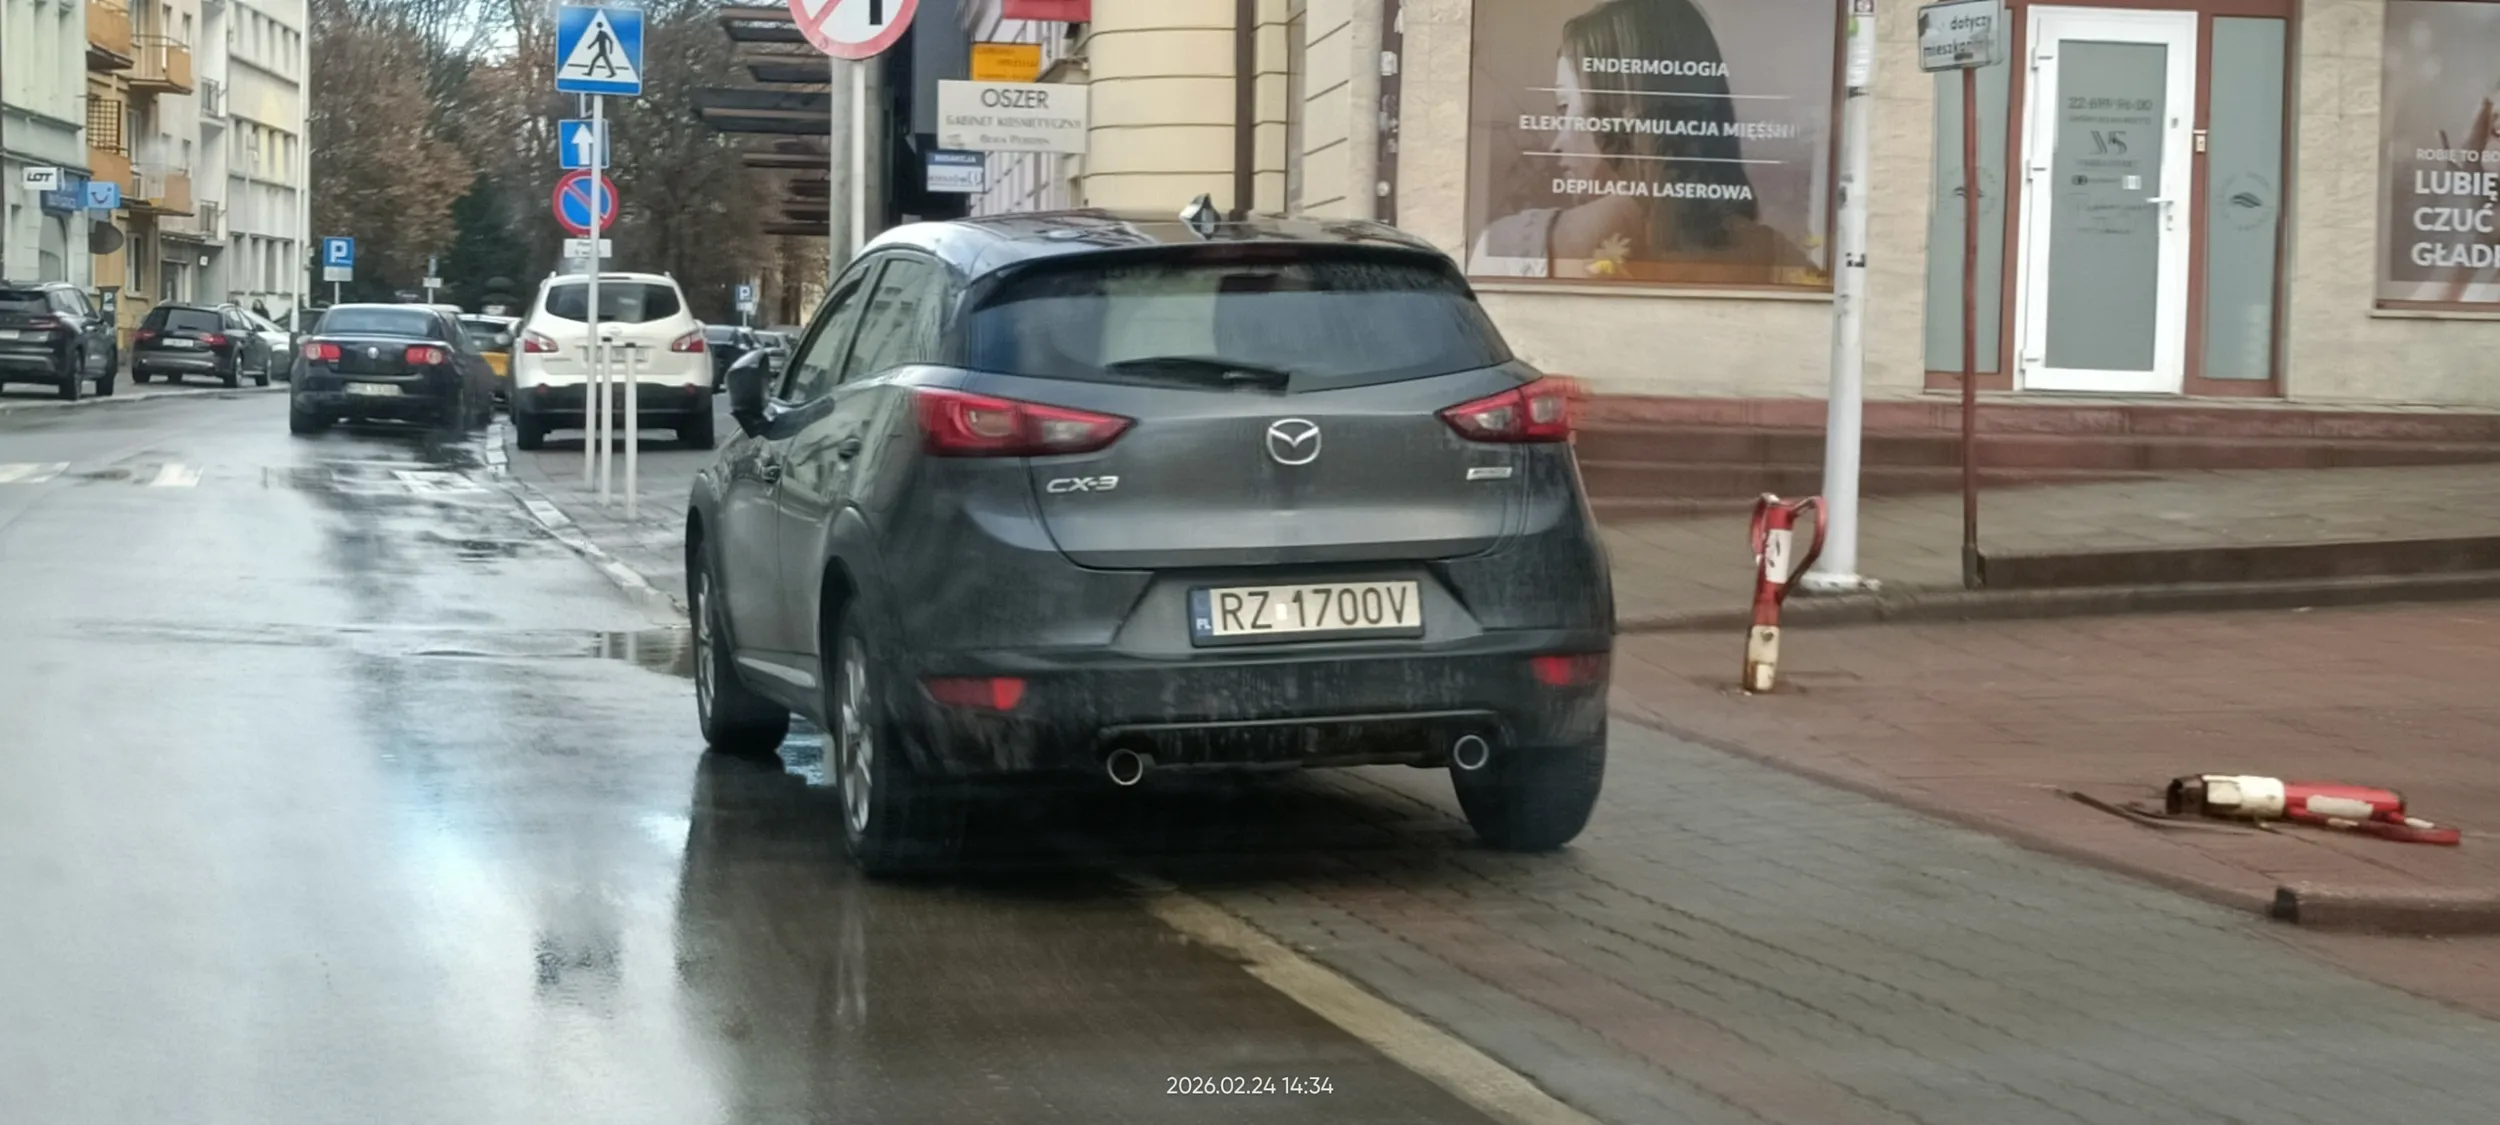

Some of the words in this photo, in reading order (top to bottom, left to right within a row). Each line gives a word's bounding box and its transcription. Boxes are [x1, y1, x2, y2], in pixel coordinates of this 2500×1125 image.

[1951, 14, 1992, 32] dotyczy
[1582, 57, 1730, 77] ENDERMOLOGIA
[981, 88, 1049, 109] OSZER
[1519, 115, 1719, 137] ELEKTROSTYMULACJA
[2460, 150, 2479, 162] TO
[27, 172, 53, 182] LOT
[2415, 170, 2499, 201] LUBIĘ
[1552, 178, 1648, 196] DEPILACJA
[1652, 182, 1753, 200] LASEROWA
[2413, 203, 2494, 233] CZUĆ
[330, 240, 348, 262] P
[1046, 476, 1119, 493] CX-3
[1220, 591, 1273, 631] RZ
[1291, 586, 1407, 628] 1700V
